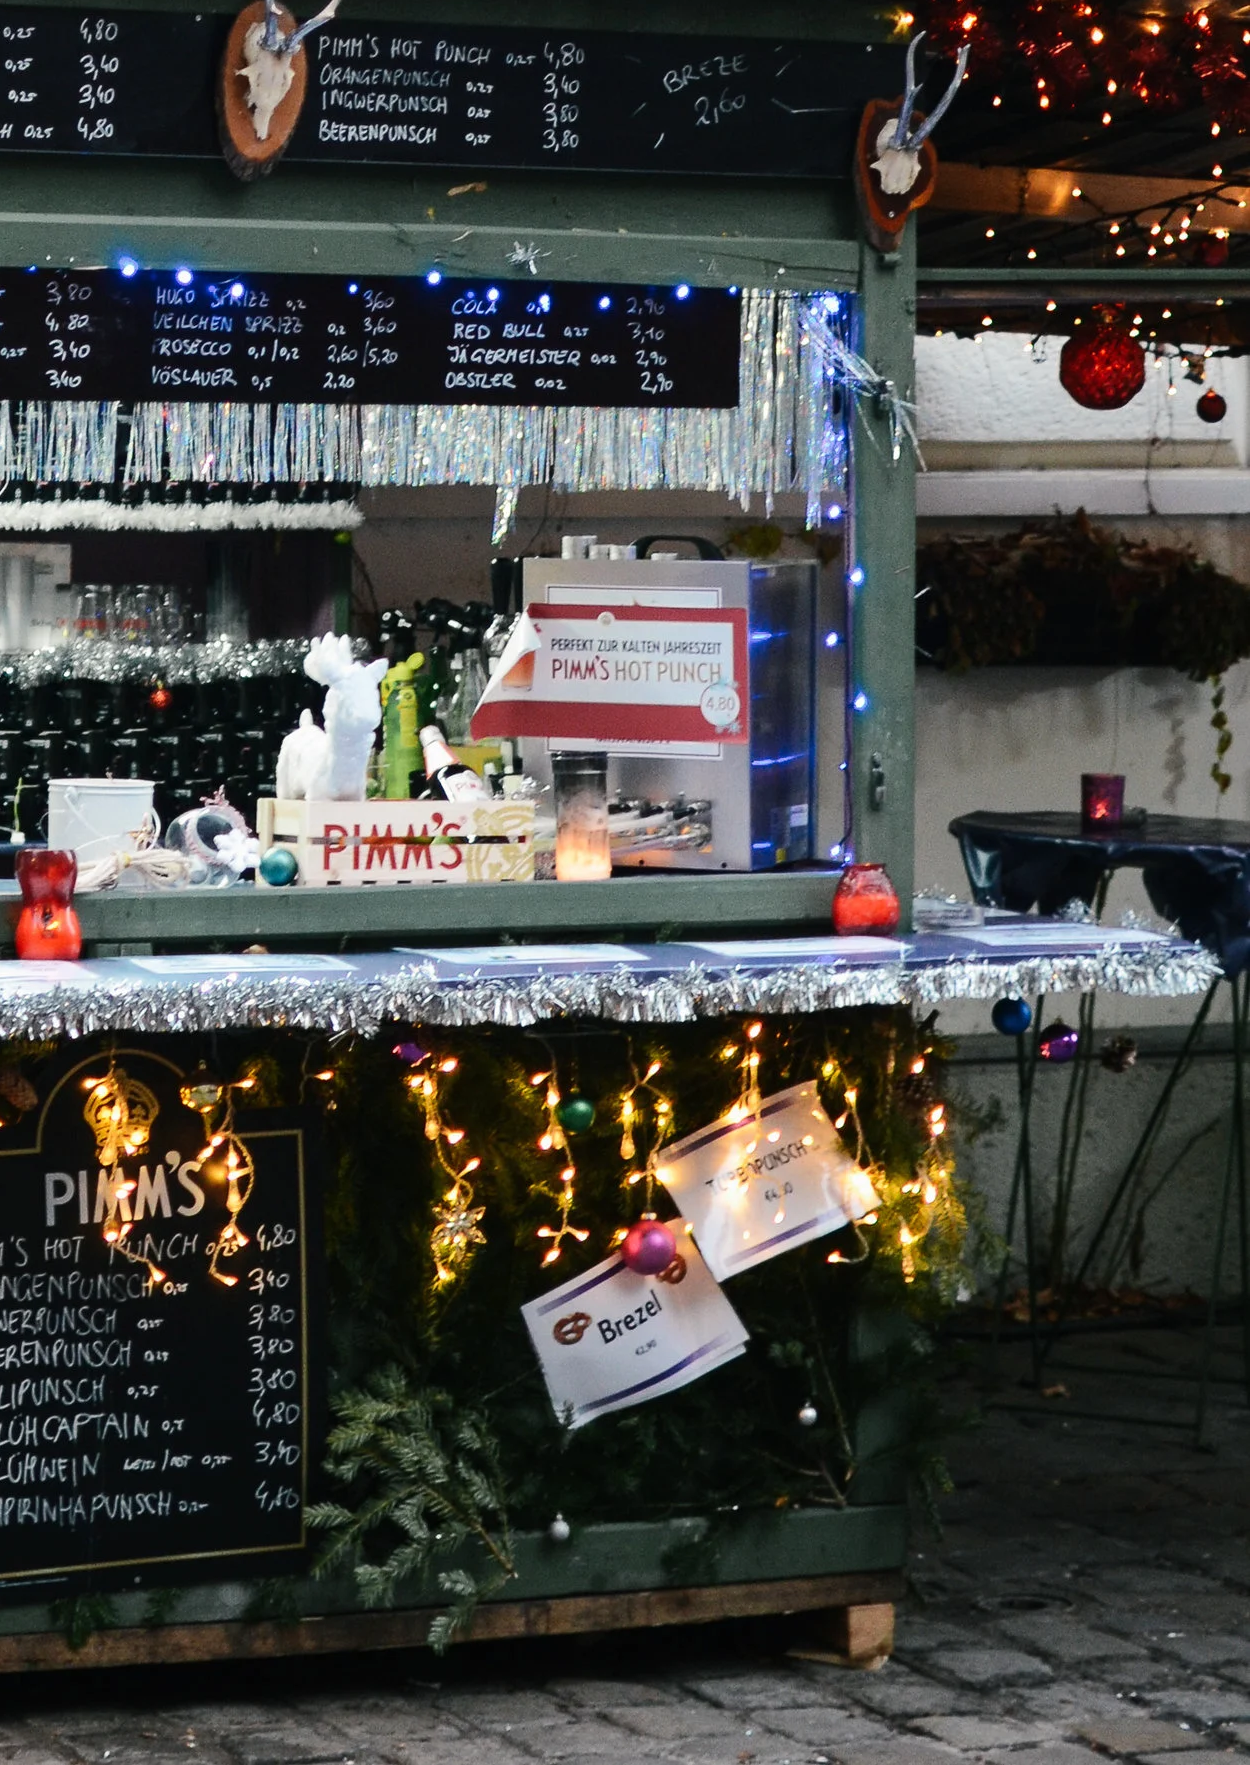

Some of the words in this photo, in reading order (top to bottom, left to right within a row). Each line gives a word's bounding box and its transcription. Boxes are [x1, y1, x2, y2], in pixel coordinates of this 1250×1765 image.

[79, 20, 118, 42] 4,80
[318, 36, 378, 60] PIMM'S
[390, 40, 423, 60] HOT
[435, 43, 491, 65] PUNCH
[543, 43, 584, 68] 4,80
[80, 55, 119, 80] 3,40
[320, 64, 450, 87] ORANGENPUNSCH
[79, 86, 114, 109] 3,40
[322, 90, 448, 114] INGWERPUNSCH
[543, 103, 578, 125] 3,80
[318, 121, 437, 143] BEERENPUNSCH
[551, 638, 593, 651] PERFEKT
[598, 640, 618, 652] ZUR
[622, 641, 659, 652] KALTEN
[664, 642, 721, 655] JAHRESZEIT
[615, 661, 652, 681] HOT
[657, 662, 720, 682] PUNCH
[322, 812, 464, 871] PIMM'S
[44, 1150, 205, 1226] PIMM'S
[598, 1290, 662, 1344] Brezel
